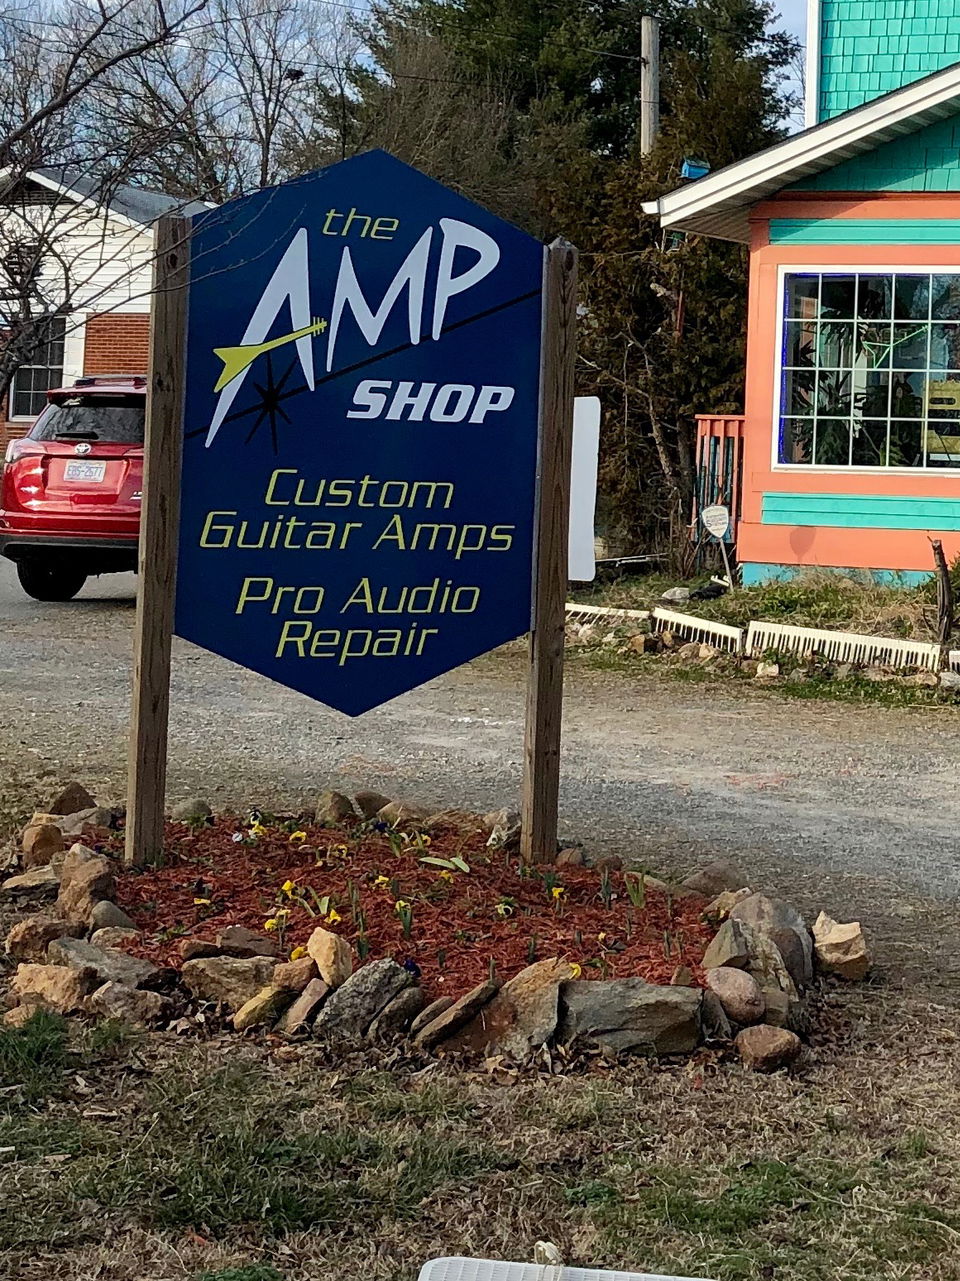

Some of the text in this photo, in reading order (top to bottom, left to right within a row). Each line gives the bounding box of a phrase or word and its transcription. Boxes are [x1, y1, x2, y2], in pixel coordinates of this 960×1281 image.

[323, 207, 399, 241] the
[204, 217, 501, 448] AMP
[346, 379, 515, 424] SHOP
[265, 469, 454, 508] Custom
[199, 510, 515, 559] Guitar Amps
[235, 577, 480, 615] Pro Audio
[275, 620, 439, 666] Repair
